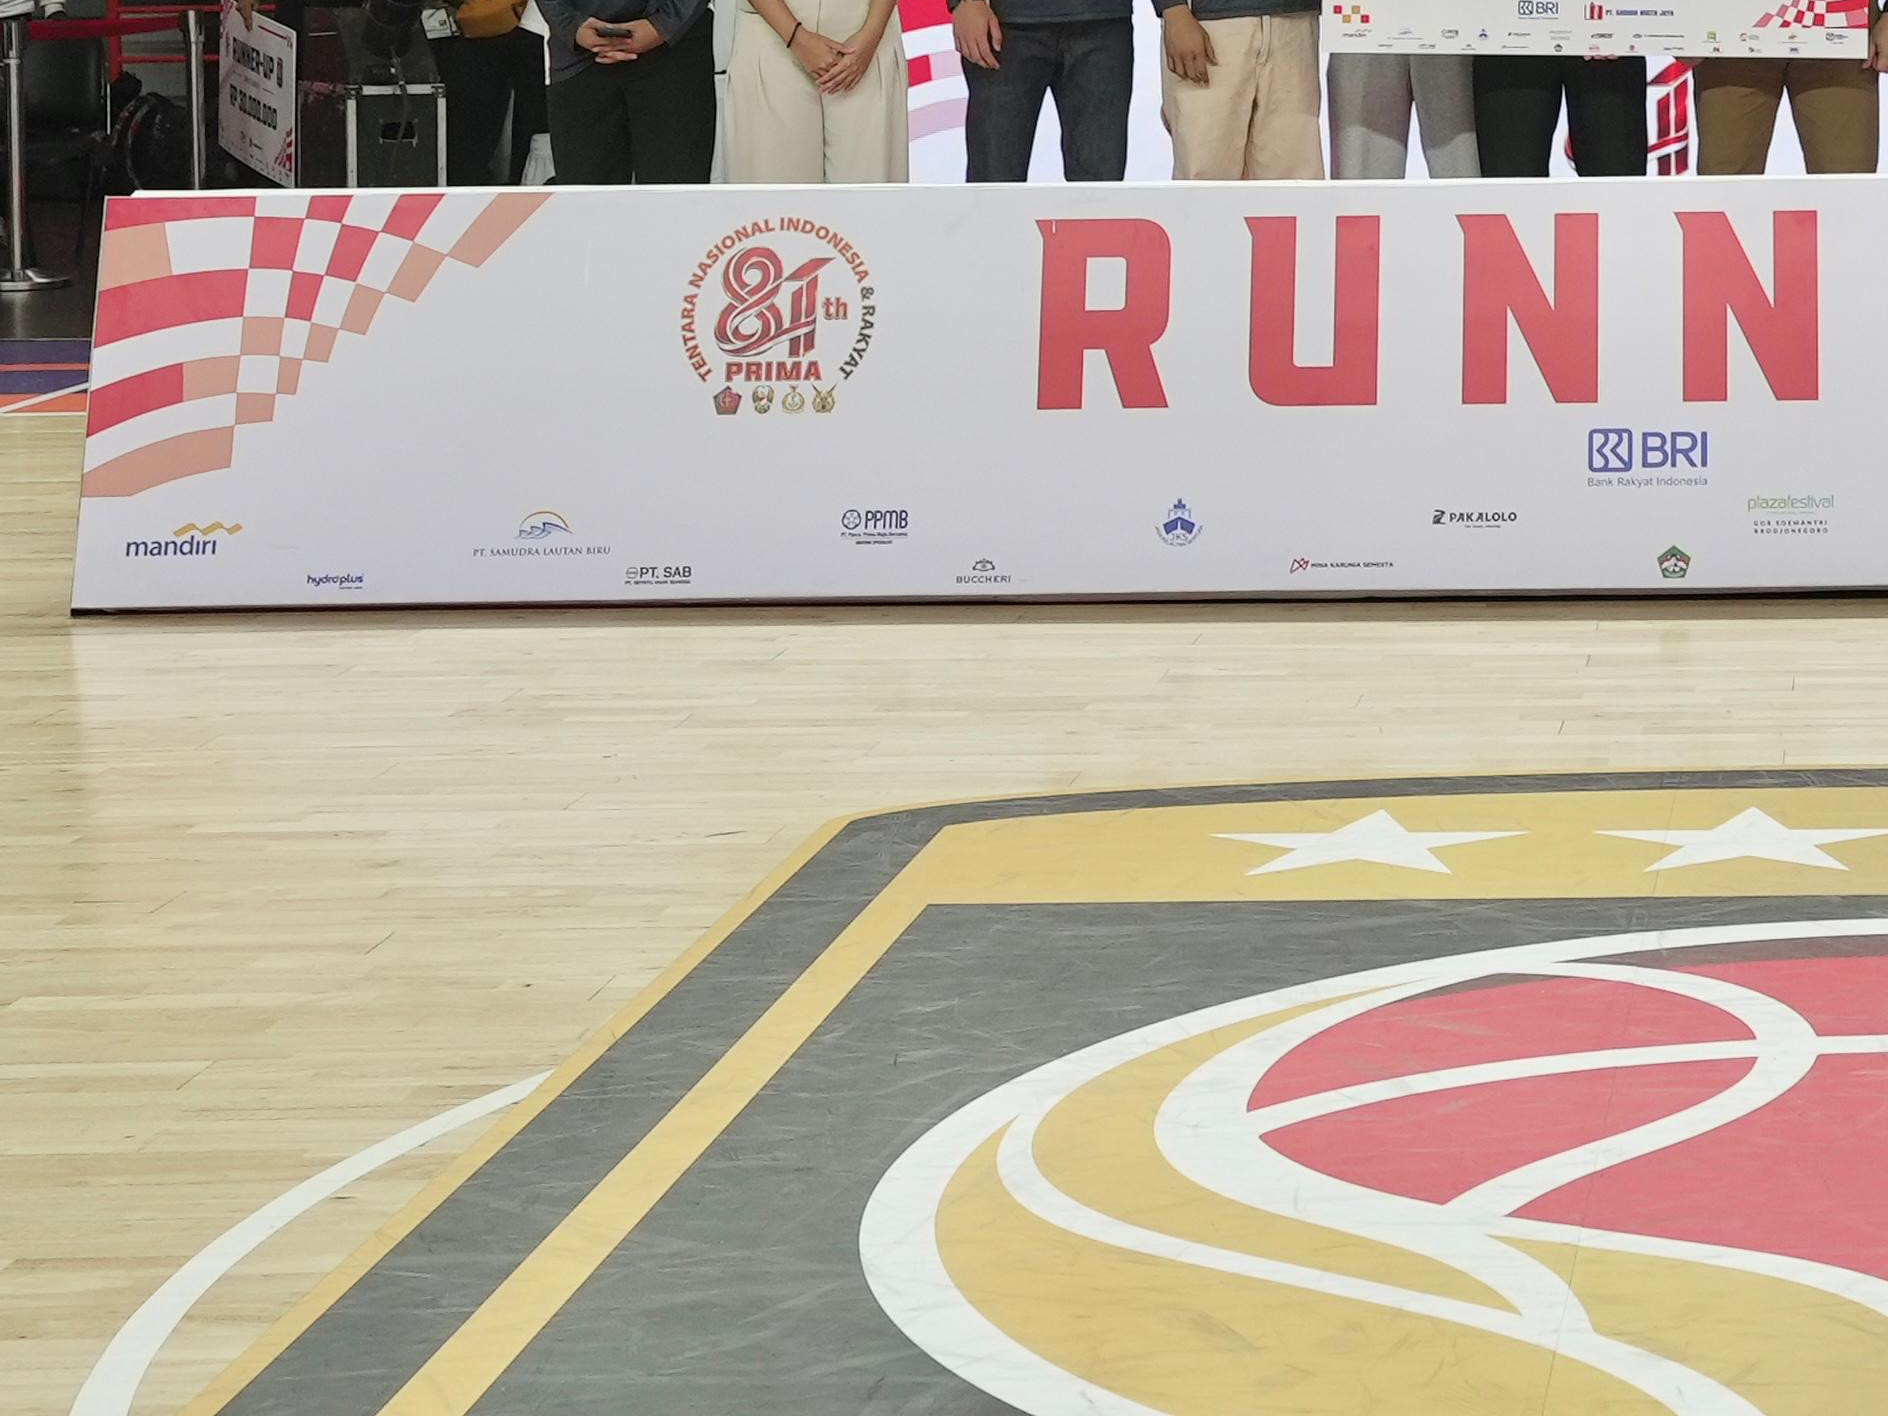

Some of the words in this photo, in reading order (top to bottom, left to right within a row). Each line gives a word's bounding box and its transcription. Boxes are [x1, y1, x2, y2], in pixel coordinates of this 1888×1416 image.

[1535, 1, 1559, 15] BRI
[232, 36, 274, 81] RUNNER-UP
[689, 219, 775, 288] NASIONAL
[780, 217, 869, 283] INDONESIA
[681, 293, 714, 382] TENTARA
[838, 304, 876, 380] RAKYAT
[725, 360, 822, 382] PRIMA
[1641, 431, 1708, 468] BRI
[1587, 477, 1613, 487] Bank
[1617, 477, 1654, 489] Rakyat
[1656, 475, 1708, 487] Indonesia
[865, 510, 908, 530] PPMB
[1448, 511, 1517, 524] PAKALOLO
[125, 535, 217, 557] mandiri
[489, 547, 540, 557] SAMUDRA
[543, 546, 582, 556] LAUTAN
[586, 545, 611, 555] BIRU
[639, 566, 660, 579] PT.
[663, 566, 692, 579] SAB
[956, 575, 1012, 584] BUCCHERI
